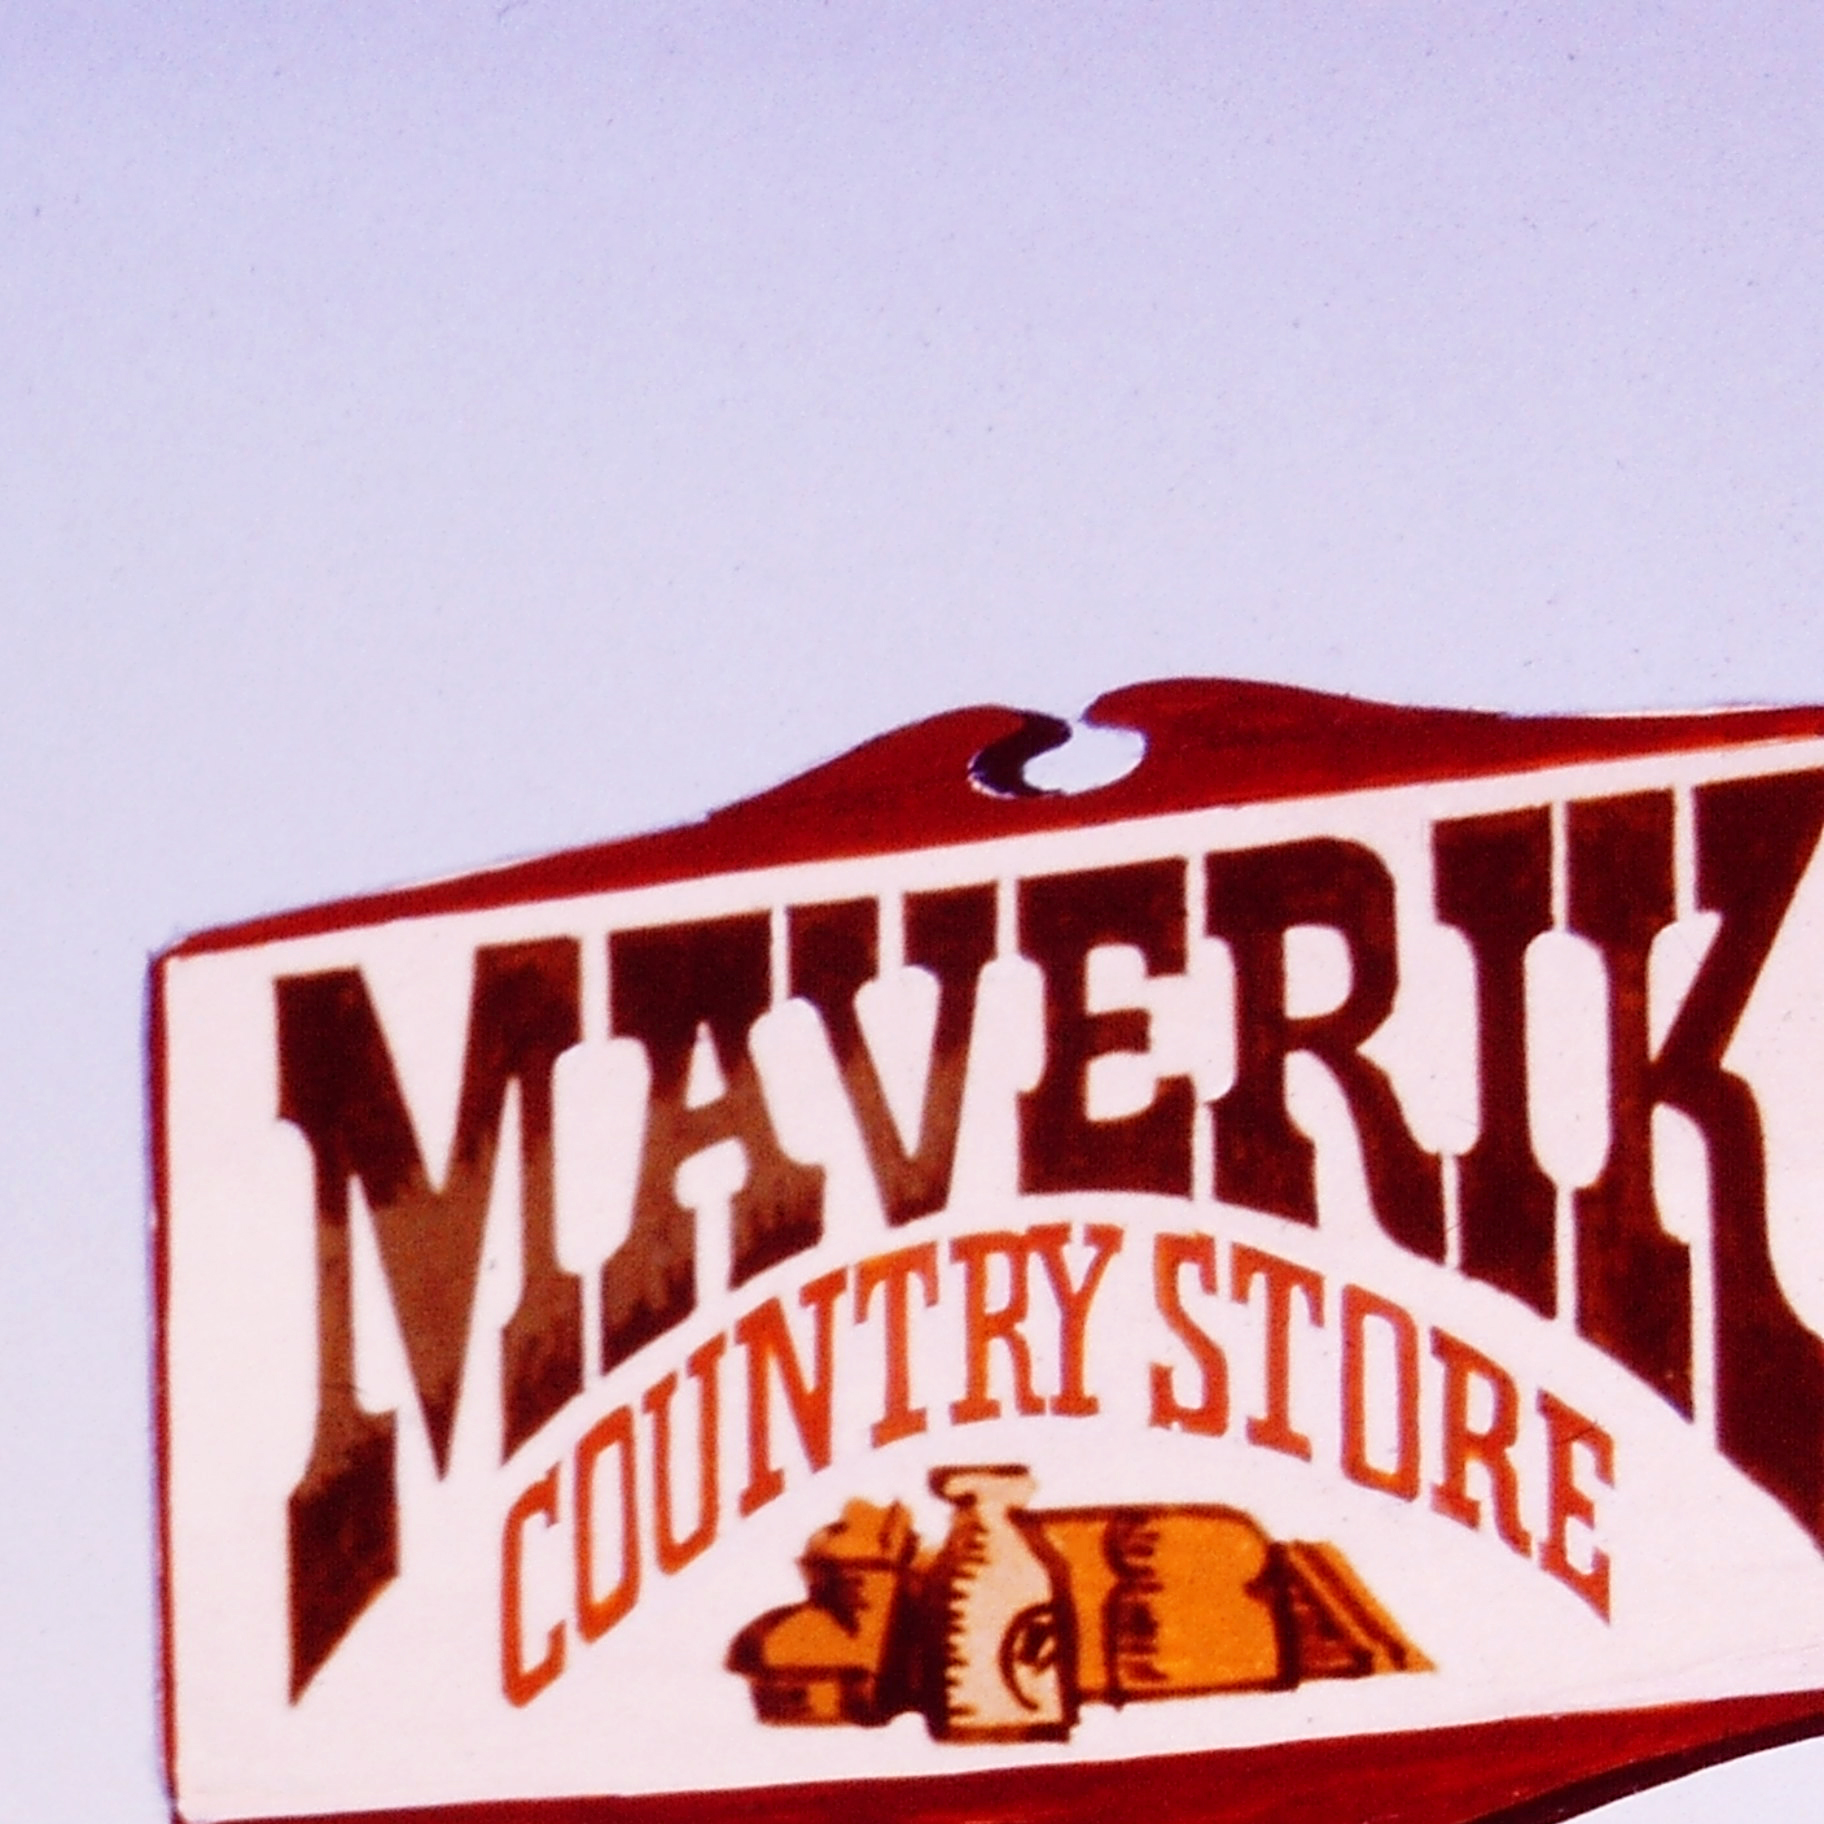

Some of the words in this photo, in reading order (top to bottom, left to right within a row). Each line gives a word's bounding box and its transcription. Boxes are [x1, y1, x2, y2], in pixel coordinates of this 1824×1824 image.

[274, 768, 1824, 1707] MAVERIK
[500, 1222, 1123, 1706] COUNTRY
[1150, 1232, 1617, 1626] STORE
